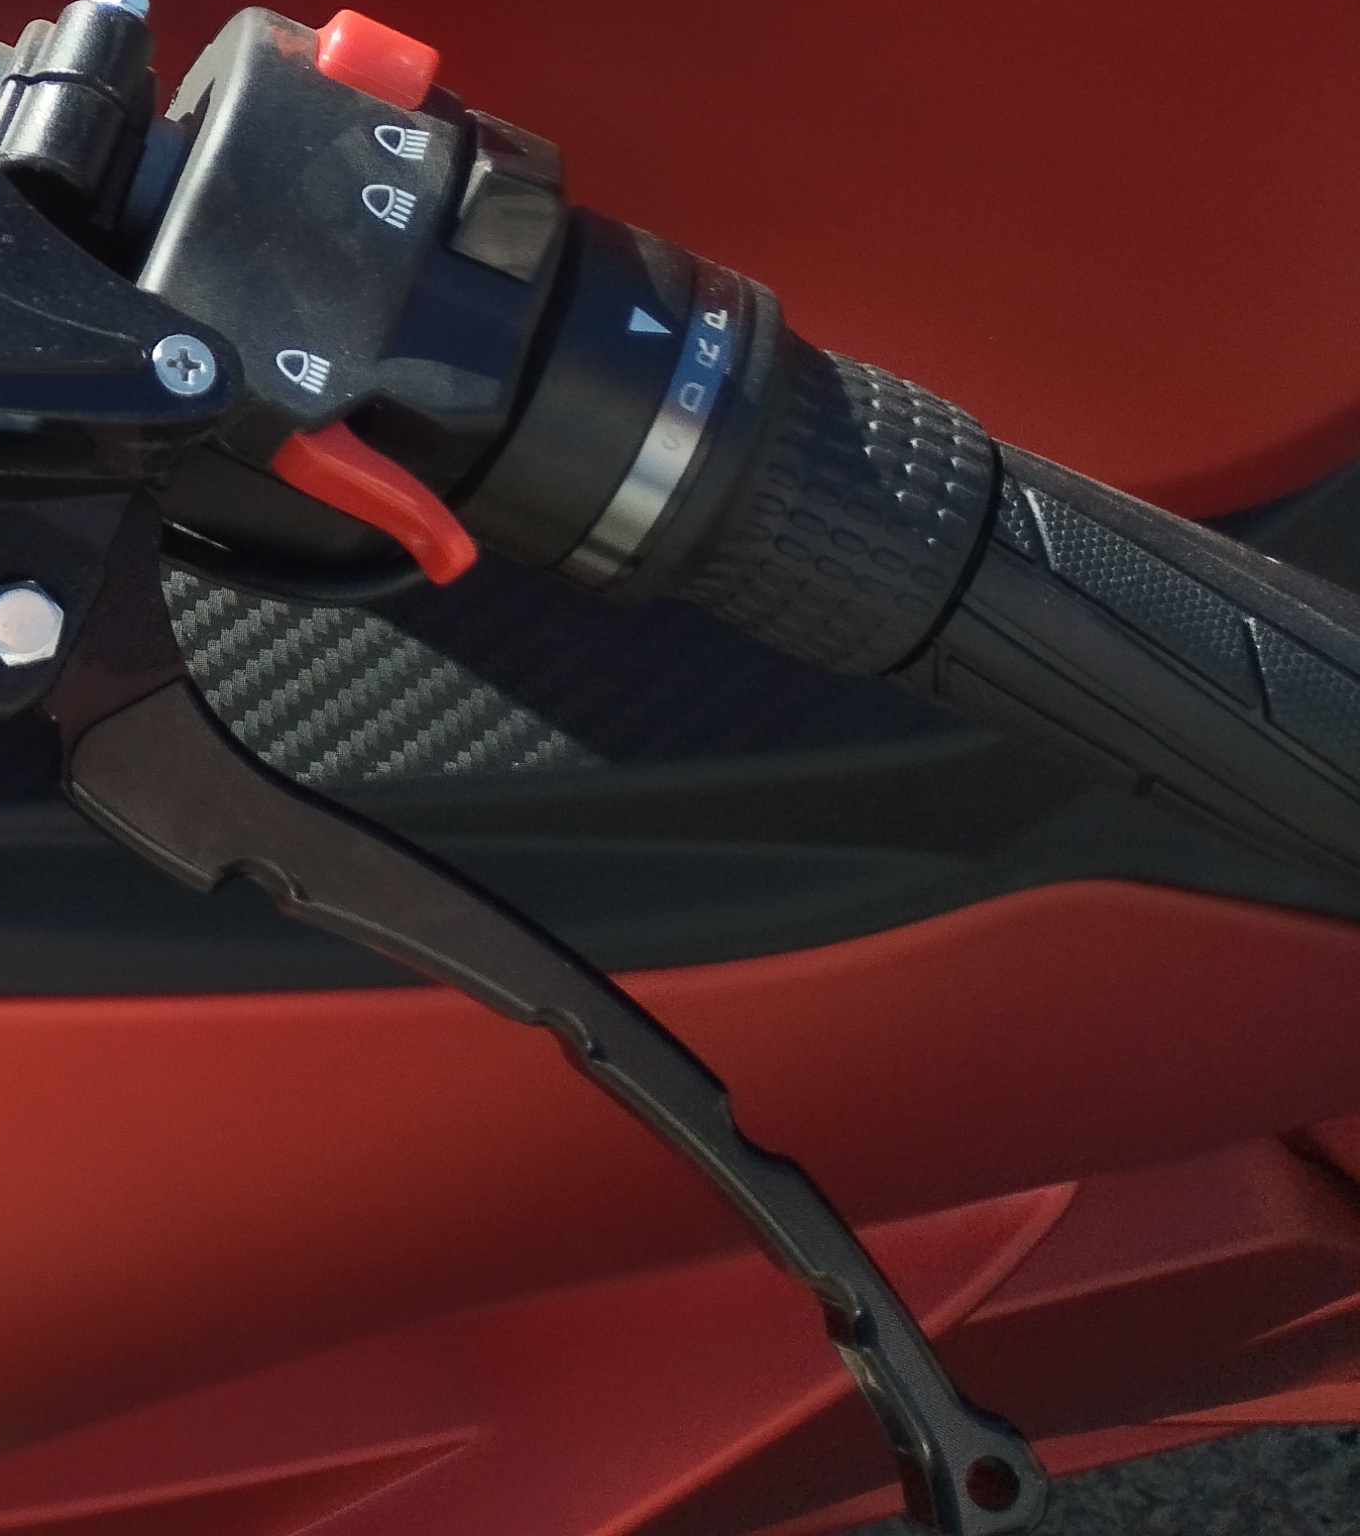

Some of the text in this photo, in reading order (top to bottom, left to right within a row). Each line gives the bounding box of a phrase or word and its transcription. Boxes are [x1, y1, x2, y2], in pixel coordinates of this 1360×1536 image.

[702, 309, 728, 331] P
[695, 337, 721, 369] R
[679, 381, 706, 414] D
